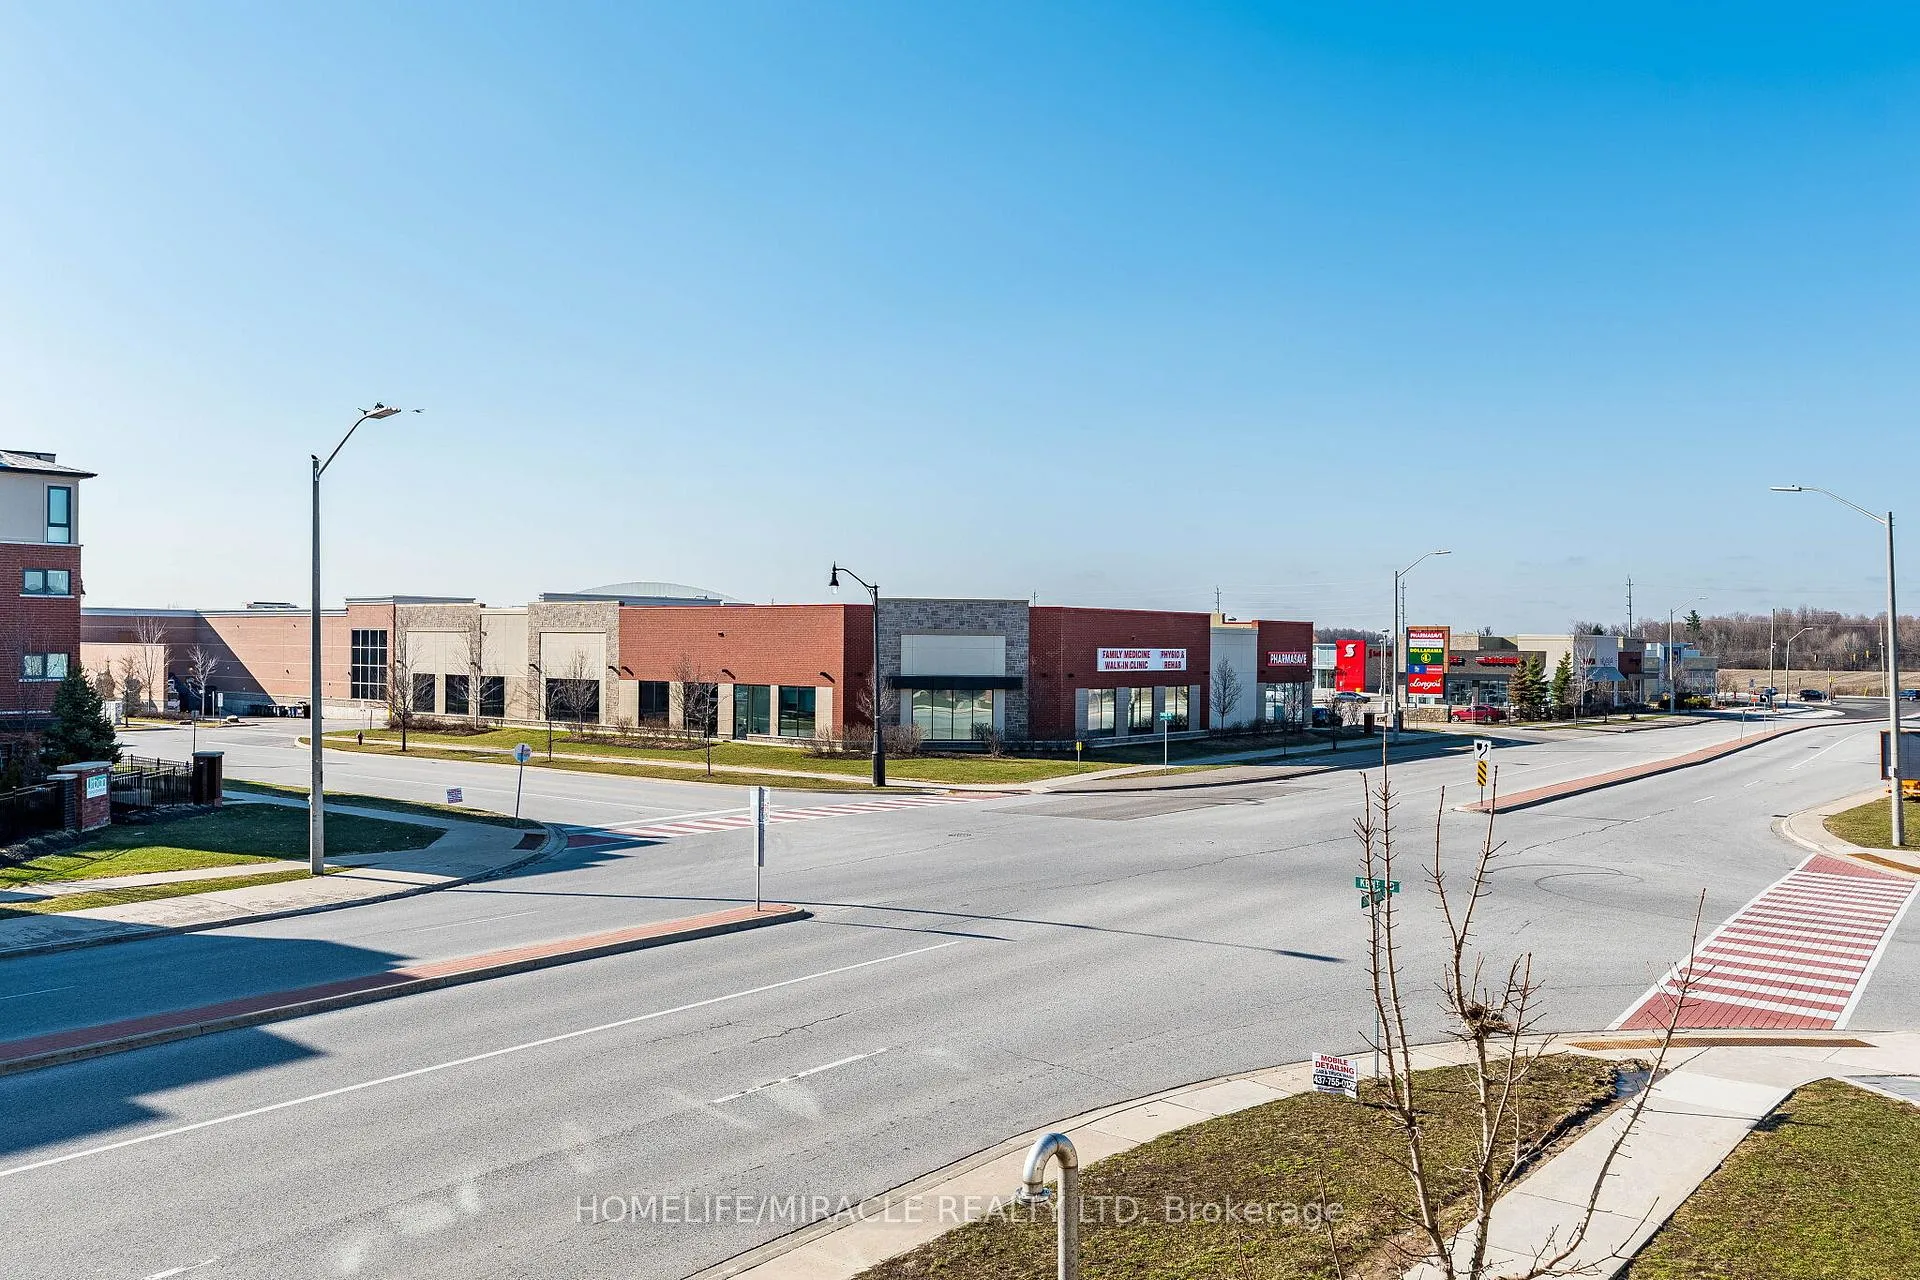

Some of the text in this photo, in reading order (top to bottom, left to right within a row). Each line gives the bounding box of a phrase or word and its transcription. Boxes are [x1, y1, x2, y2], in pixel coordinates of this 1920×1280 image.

[1160, 651, 1179, 659] PHYSIO
[1271, 653, 1306, 664] PHARMASAVE
[1105, 661, 1148, 669] WALK-IN CLINIC
[1164, 661, 1181, 669] REHAB
[1321, 1055, 1348, 1066] MOBILE
[1315, 1061, 1354, 1074] DETAILING
